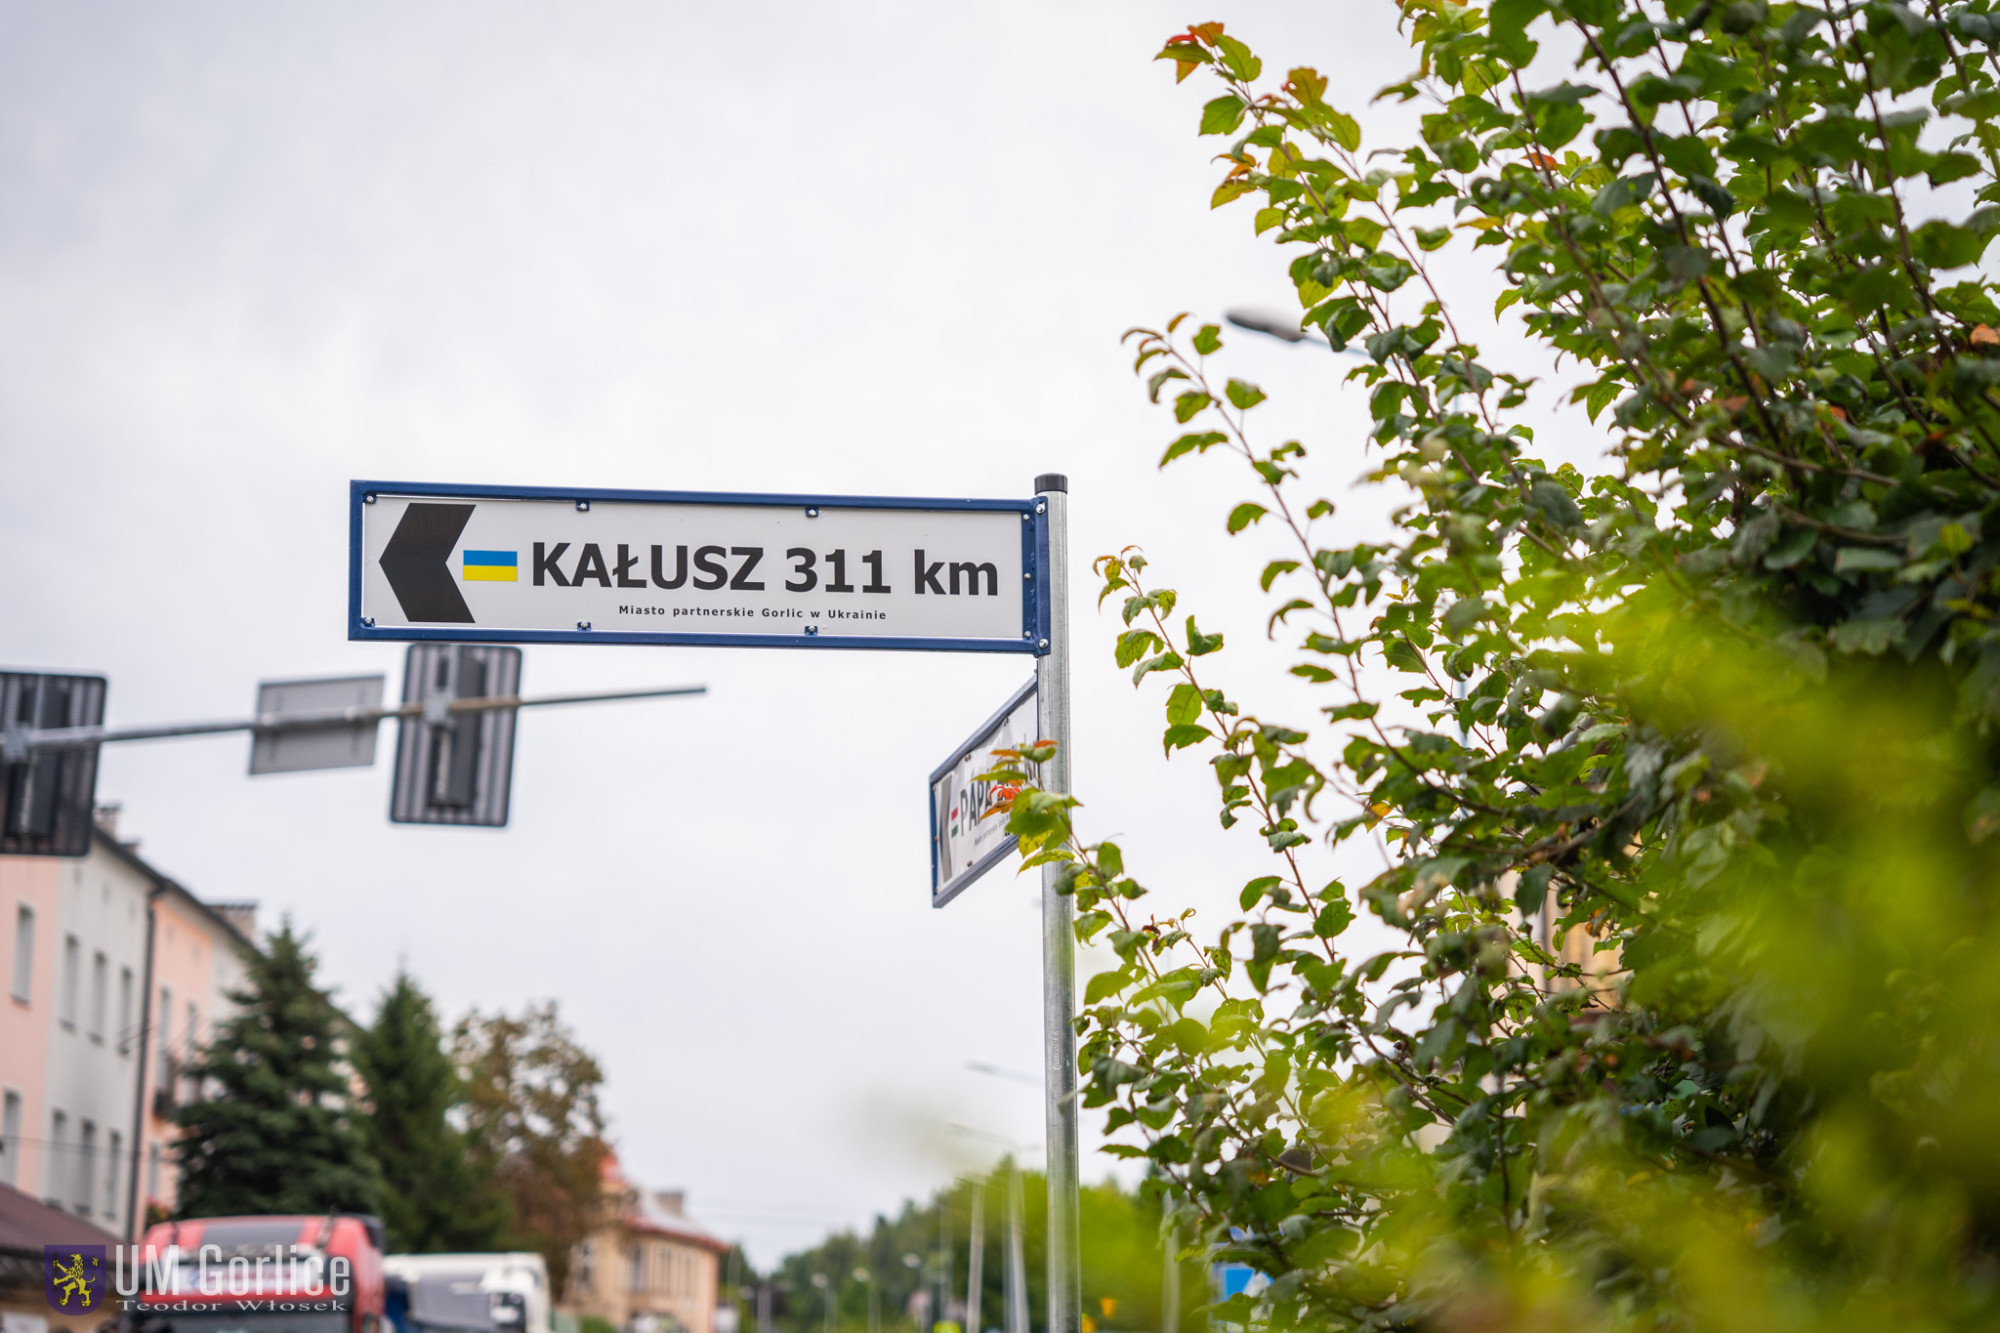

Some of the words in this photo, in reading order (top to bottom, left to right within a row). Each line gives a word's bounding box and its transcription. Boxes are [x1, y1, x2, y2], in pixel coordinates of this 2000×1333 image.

[532, 541, 765, 591] KAŁUSZ
[785, 547, 892, 594] 311
[914, 548, 998, 597] km
[618, 604, 666, 616] Miasto
[672, 606, 755, 618] partnerskie
[761, 607, 804, 619] Gorlic
[809, 610, 821, 619] w
[827, 609, 887, 620] Ukrainie
